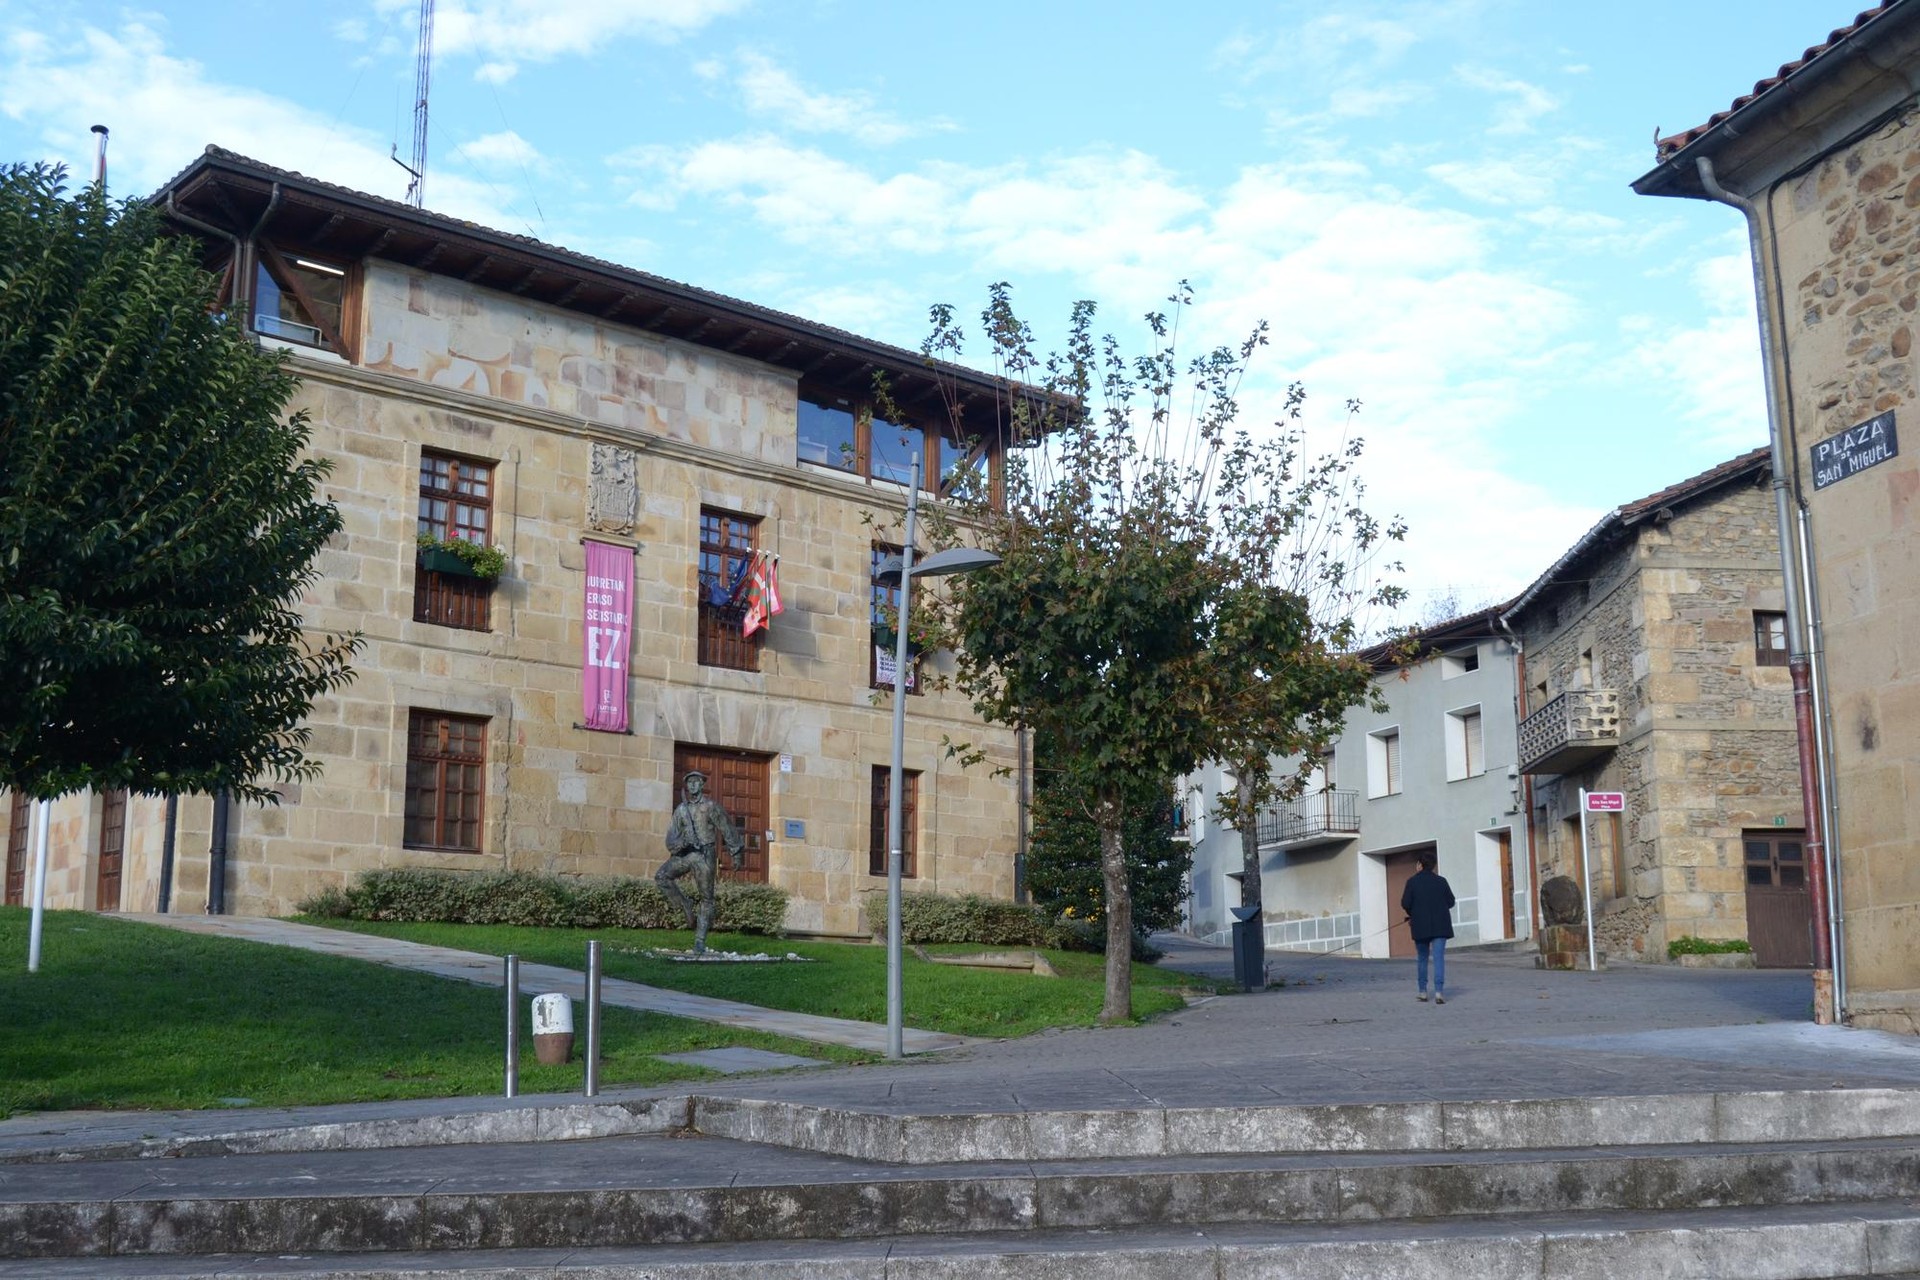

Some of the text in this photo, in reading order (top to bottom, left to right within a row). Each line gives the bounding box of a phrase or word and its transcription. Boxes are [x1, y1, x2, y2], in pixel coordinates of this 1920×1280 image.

[1818, 420, 1884, 461] PLAZA
[1817, 442, 1892, 487] SAN MIGUEL
[588, 626, 620, 669] EZ
